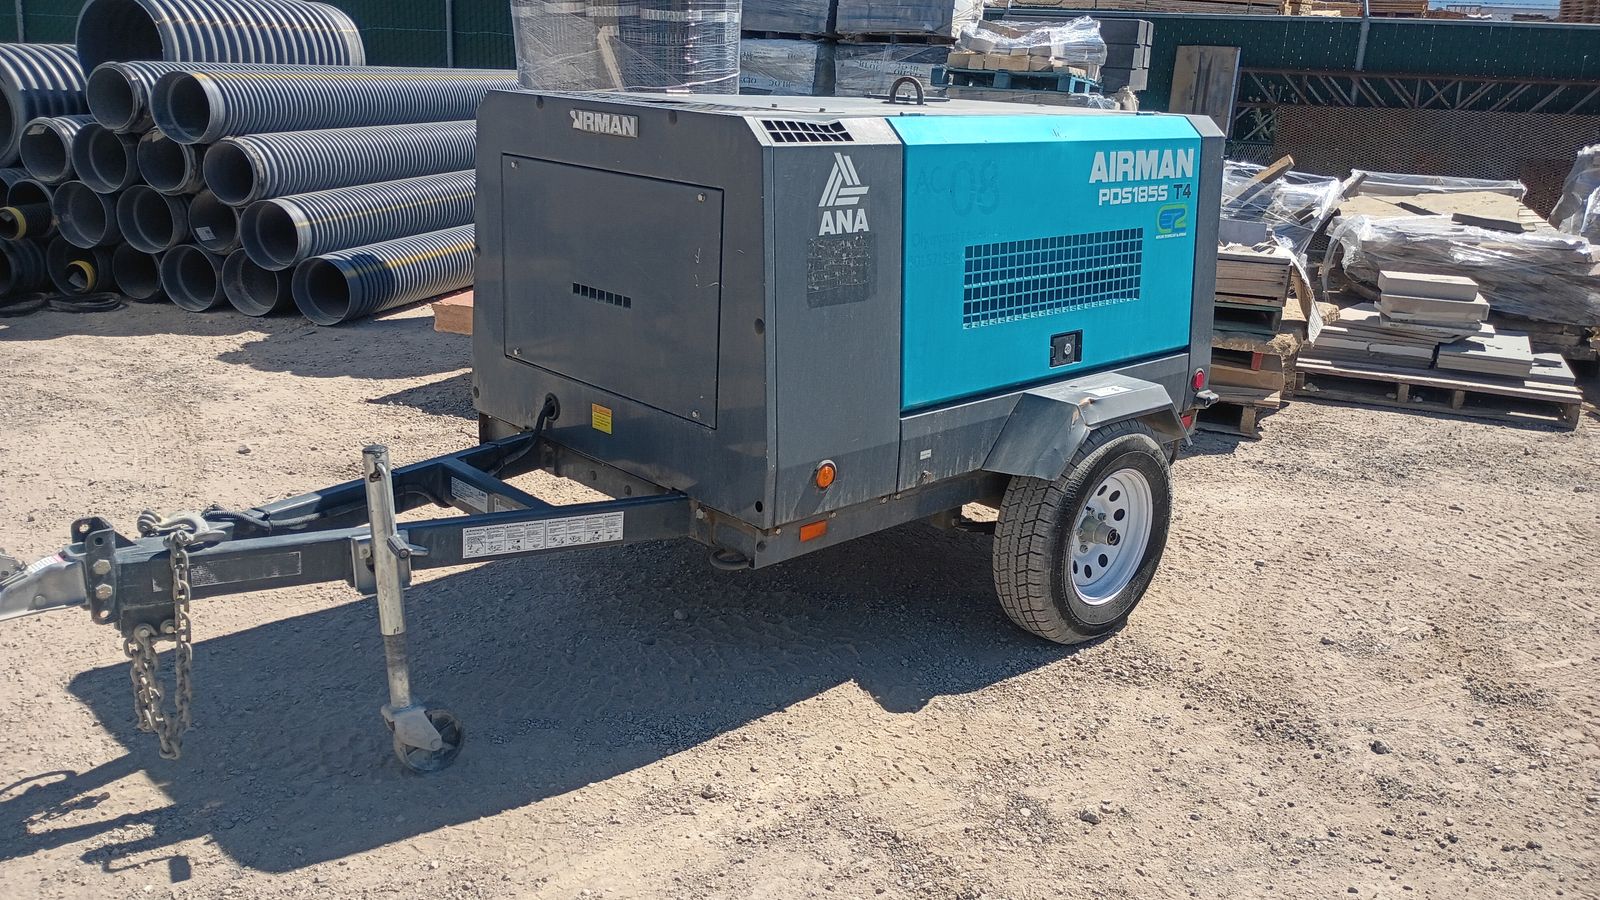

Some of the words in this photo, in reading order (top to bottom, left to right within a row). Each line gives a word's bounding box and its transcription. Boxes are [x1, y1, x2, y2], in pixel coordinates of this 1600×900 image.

[1088, 148, 1194, 184] AIRMAN
[1098, 185, 1168, 206] PDS185S
[1173, 183, 1191, 199] T4
[818, 208, 870, 236] ANA
